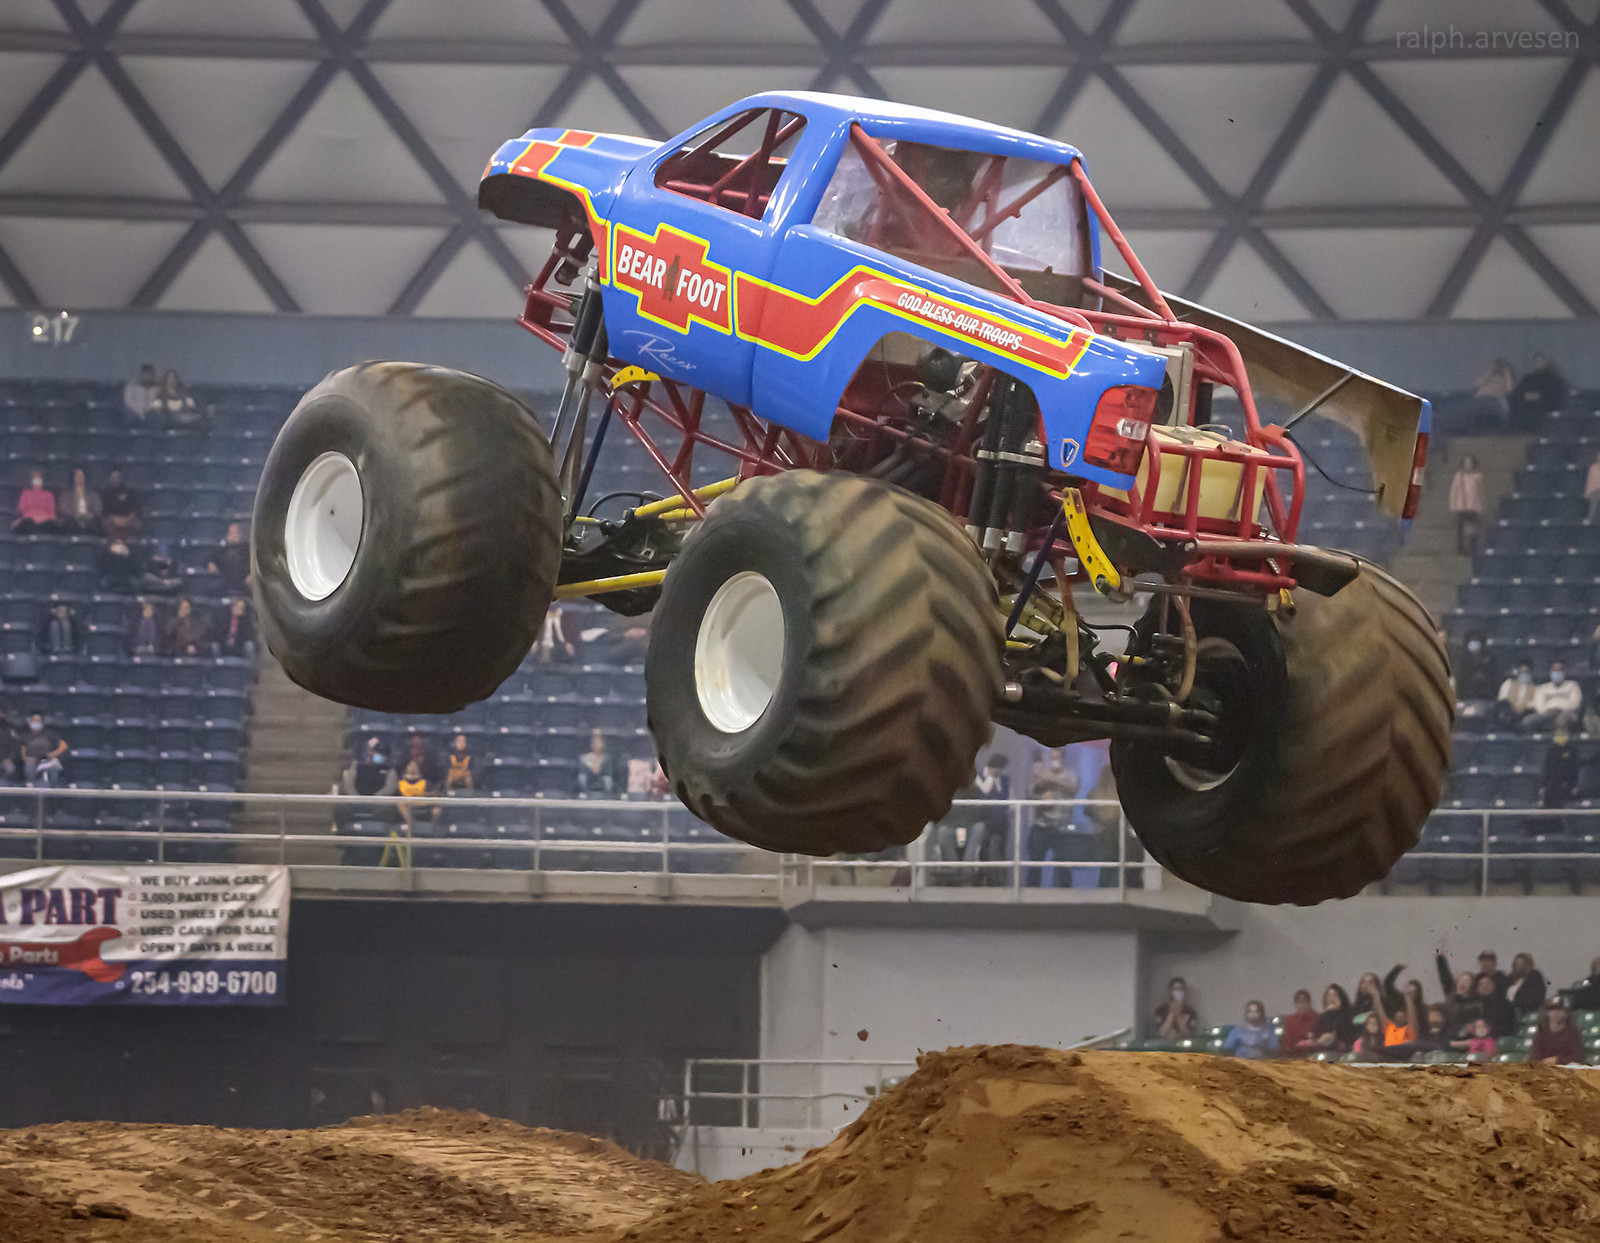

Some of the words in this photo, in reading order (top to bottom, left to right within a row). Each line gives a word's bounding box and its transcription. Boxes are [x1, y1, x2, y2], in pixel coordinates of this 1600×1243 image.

[617, 244, 667, 289] BEAR
[676, 268, 726, 312] FOOT
[33, 314, 79, 344] 217
[897, 292, 922, 312] GOD
[919, 300, 956, 325] BLESS
[954, 313, 980, 335] OUR
[978, 322, 1023, 351] TROOPS
[140, 876, 160, 886] WE
[164, 876, 190, 886] BUY
[194, 876, 230, 886] JUNK
[233, 875, 268, 885] CARS
[178, 892, 219, 902] PARTS
[222, 892, 256, 901] CARS
[20, 888, 122, 925] PART
[140, 909, 175, 919] USED
[179, 909, 216, 919] TIRES
[220, 908, 244, 918] FOR
[247, 908, 279, 918] SALE
[140, 926, 174, 935] USED
[179, 926, 213, 936] CARS
[216, 925, 241, 935] FOR
[245, 925, 277, 935] SALE
[10, 946, 58, 963] Parts
[140, 942, 175, 952] OPEN
[178, 943, 185, 951] 7
[189, 942, 221, 952] DAYS
[224, 942, 234, 951] A
[237, 942, 273, 952] WEEK
[130, 971, 277, 994] 254-939-6700
